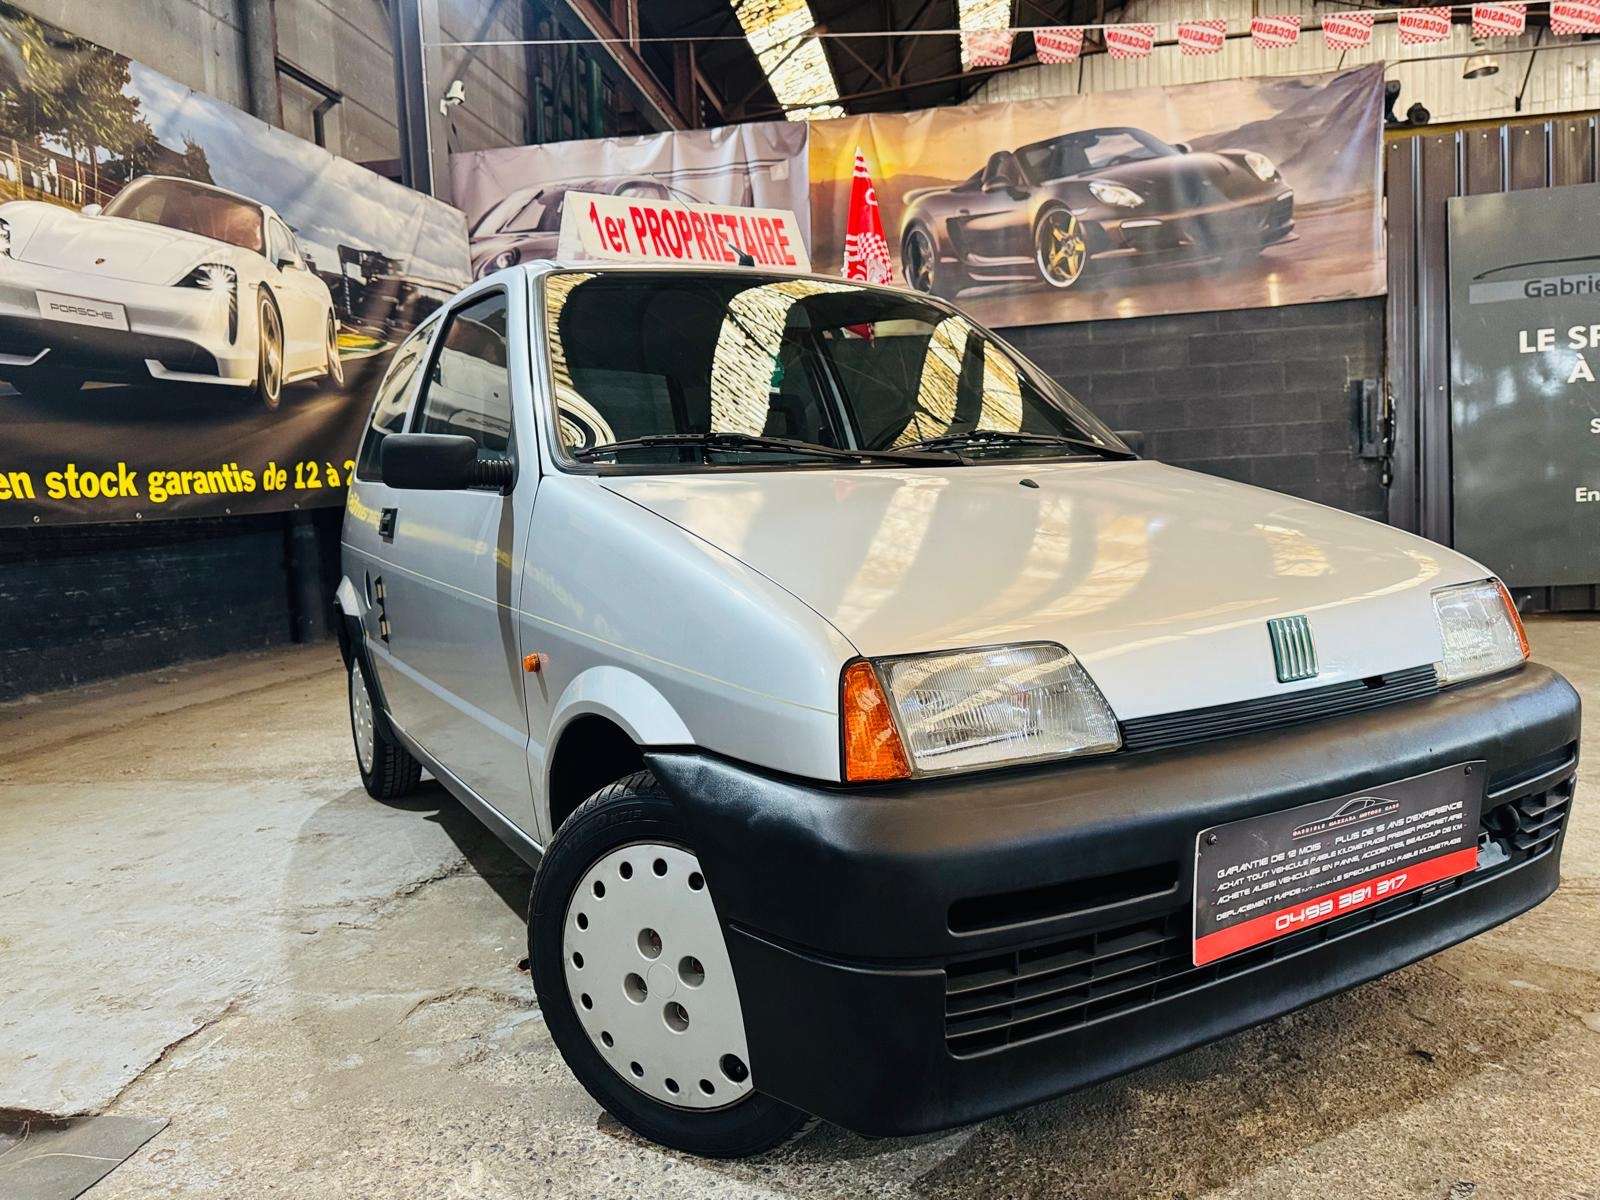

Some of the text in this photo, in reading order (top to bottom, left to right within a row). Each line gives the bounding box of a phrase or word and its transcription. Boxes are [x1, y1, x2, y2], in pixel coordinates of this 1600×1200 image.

[589, 202, 797, 266] 1er PROPRIETAIRE
[50, 302, 114, 320] PORSCHE
[1519, 328, 1556, 354] LE
[1567, 352, 1596, 384] À
[45, 462, 139, 499] stock
[147, 462, 256, 503] garantis
[263, 462, 287, 491] de
[294, 461, 322, 489] 12
[326, 462, 341, 487] à
[1217, 857, 1269, 879] GARANTIE
[1271, 852, 1286, 863] DE
[1287, 849, 1297, 858] 12
[1299, 842, 1322, 855] MOIS
[1335, 830, 1360, 845] PLUS
[1361, 826, 1375, 838] DE
[1387, 817, 1405, 830] ANS
[1217, 877, 1245, 892] ACHAT
[1247, 870, 1270, 882] TOUT
[1271, 858, 1309, 875] VEHICULE
[1337, 837, 1386, 855] KILOMETRAGE
[1386, 826, 1416, 841] PREMIER
[1217, 888, 1251, 905] ACHETE
[1252, 880, 1277, 893] AUSSI
[1278, 866, 1321, 885] VEHICULES
[1321, 863, 1333, 872] EN
[1405, 830, 1441, 846] BEAUCOUP
[1442, 826, 1452, 835] DE
[1452, 823, 1463, 831] KM
[1216, 896, 1273, 921] DEPLACEMENT
[1274, 887, 1302, 901] RAPIDE
[1333, 874, 1343, 883] LE
[1343, 861, 1386, 879] SPECIALISTE
[1386, 857, 1396, 866] DU
[1275, 899, 1334, 931] 0493
[1376, 873, 1408, 896] 317
